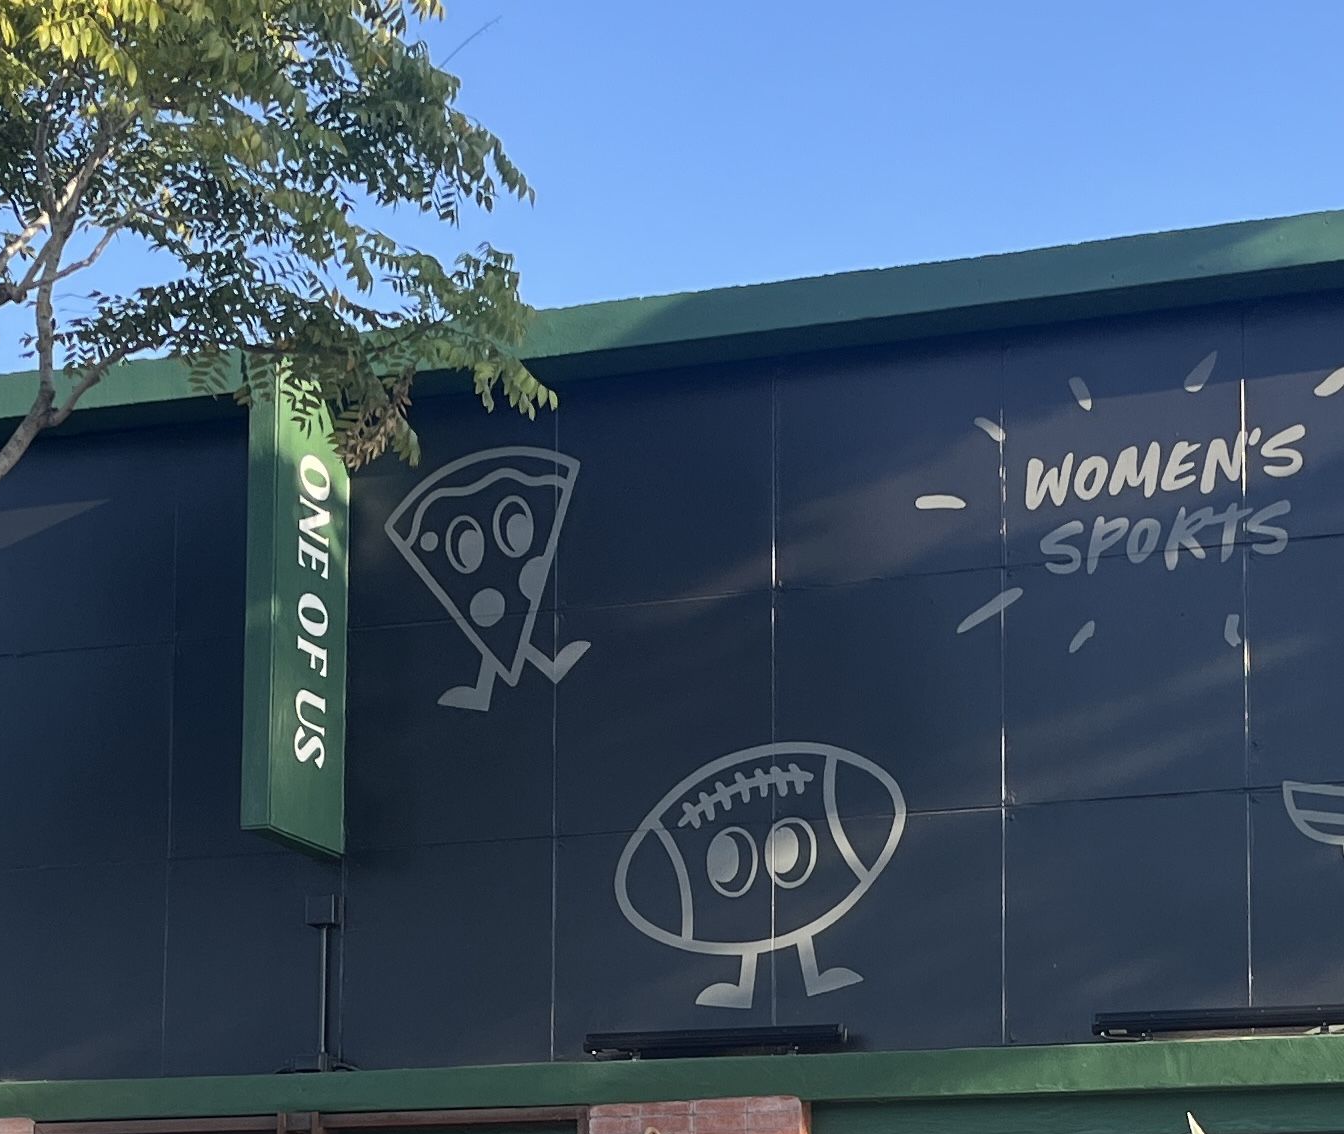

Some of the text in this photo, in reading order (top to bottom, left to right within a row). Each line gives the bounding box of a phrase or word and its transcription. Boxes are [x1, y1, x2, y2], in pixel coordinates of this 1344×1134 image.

[1025, 424, 1306, 511] WOMEN'S
[1039, 500, 1292, 575] SPORTS
[294, 454, 331, 770] ONE OF US
